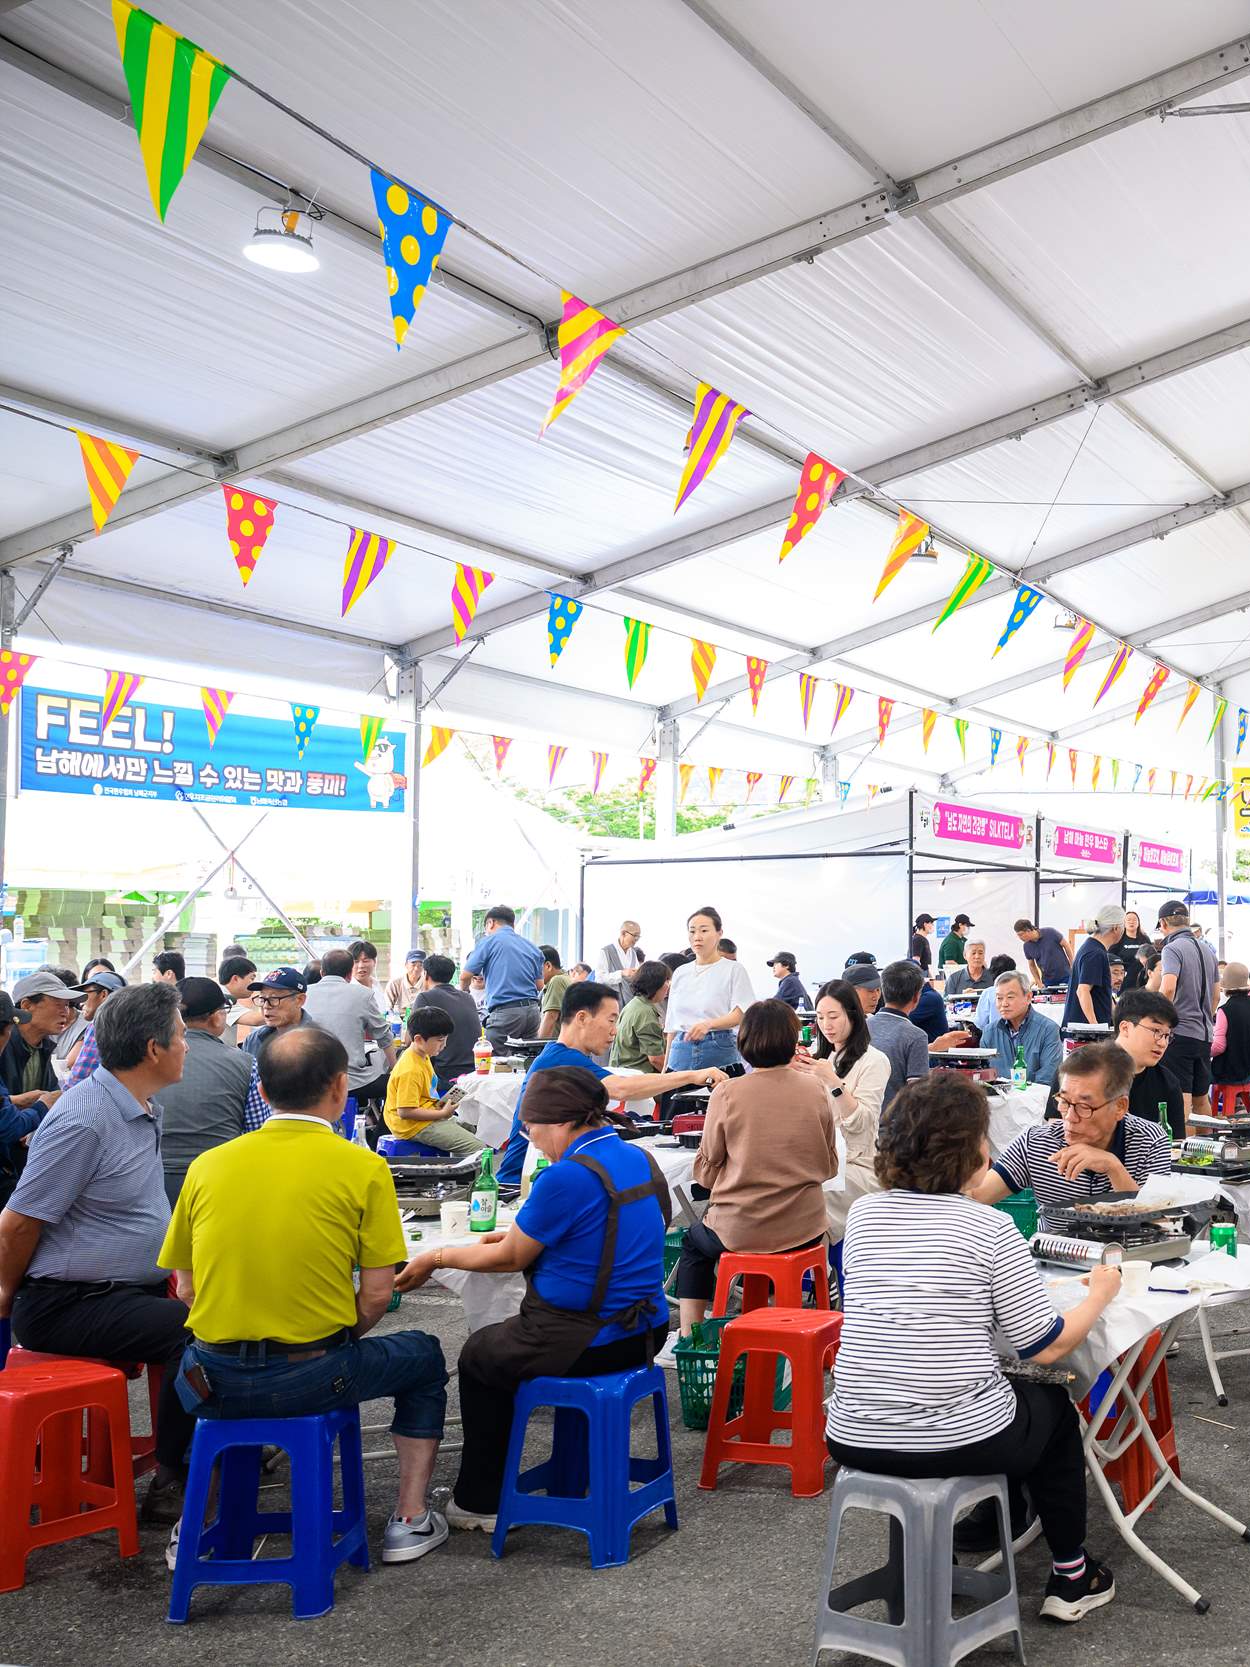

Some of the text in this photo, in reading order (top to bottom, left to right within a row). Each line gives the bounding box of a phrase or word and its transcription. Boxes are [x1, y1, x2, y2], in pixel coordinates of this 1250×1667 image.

[36, 692, 175, 755] FEEL!
[35, 746, 346, 797] 남해에서만 느낄 수 있는 맛과 풍미!
